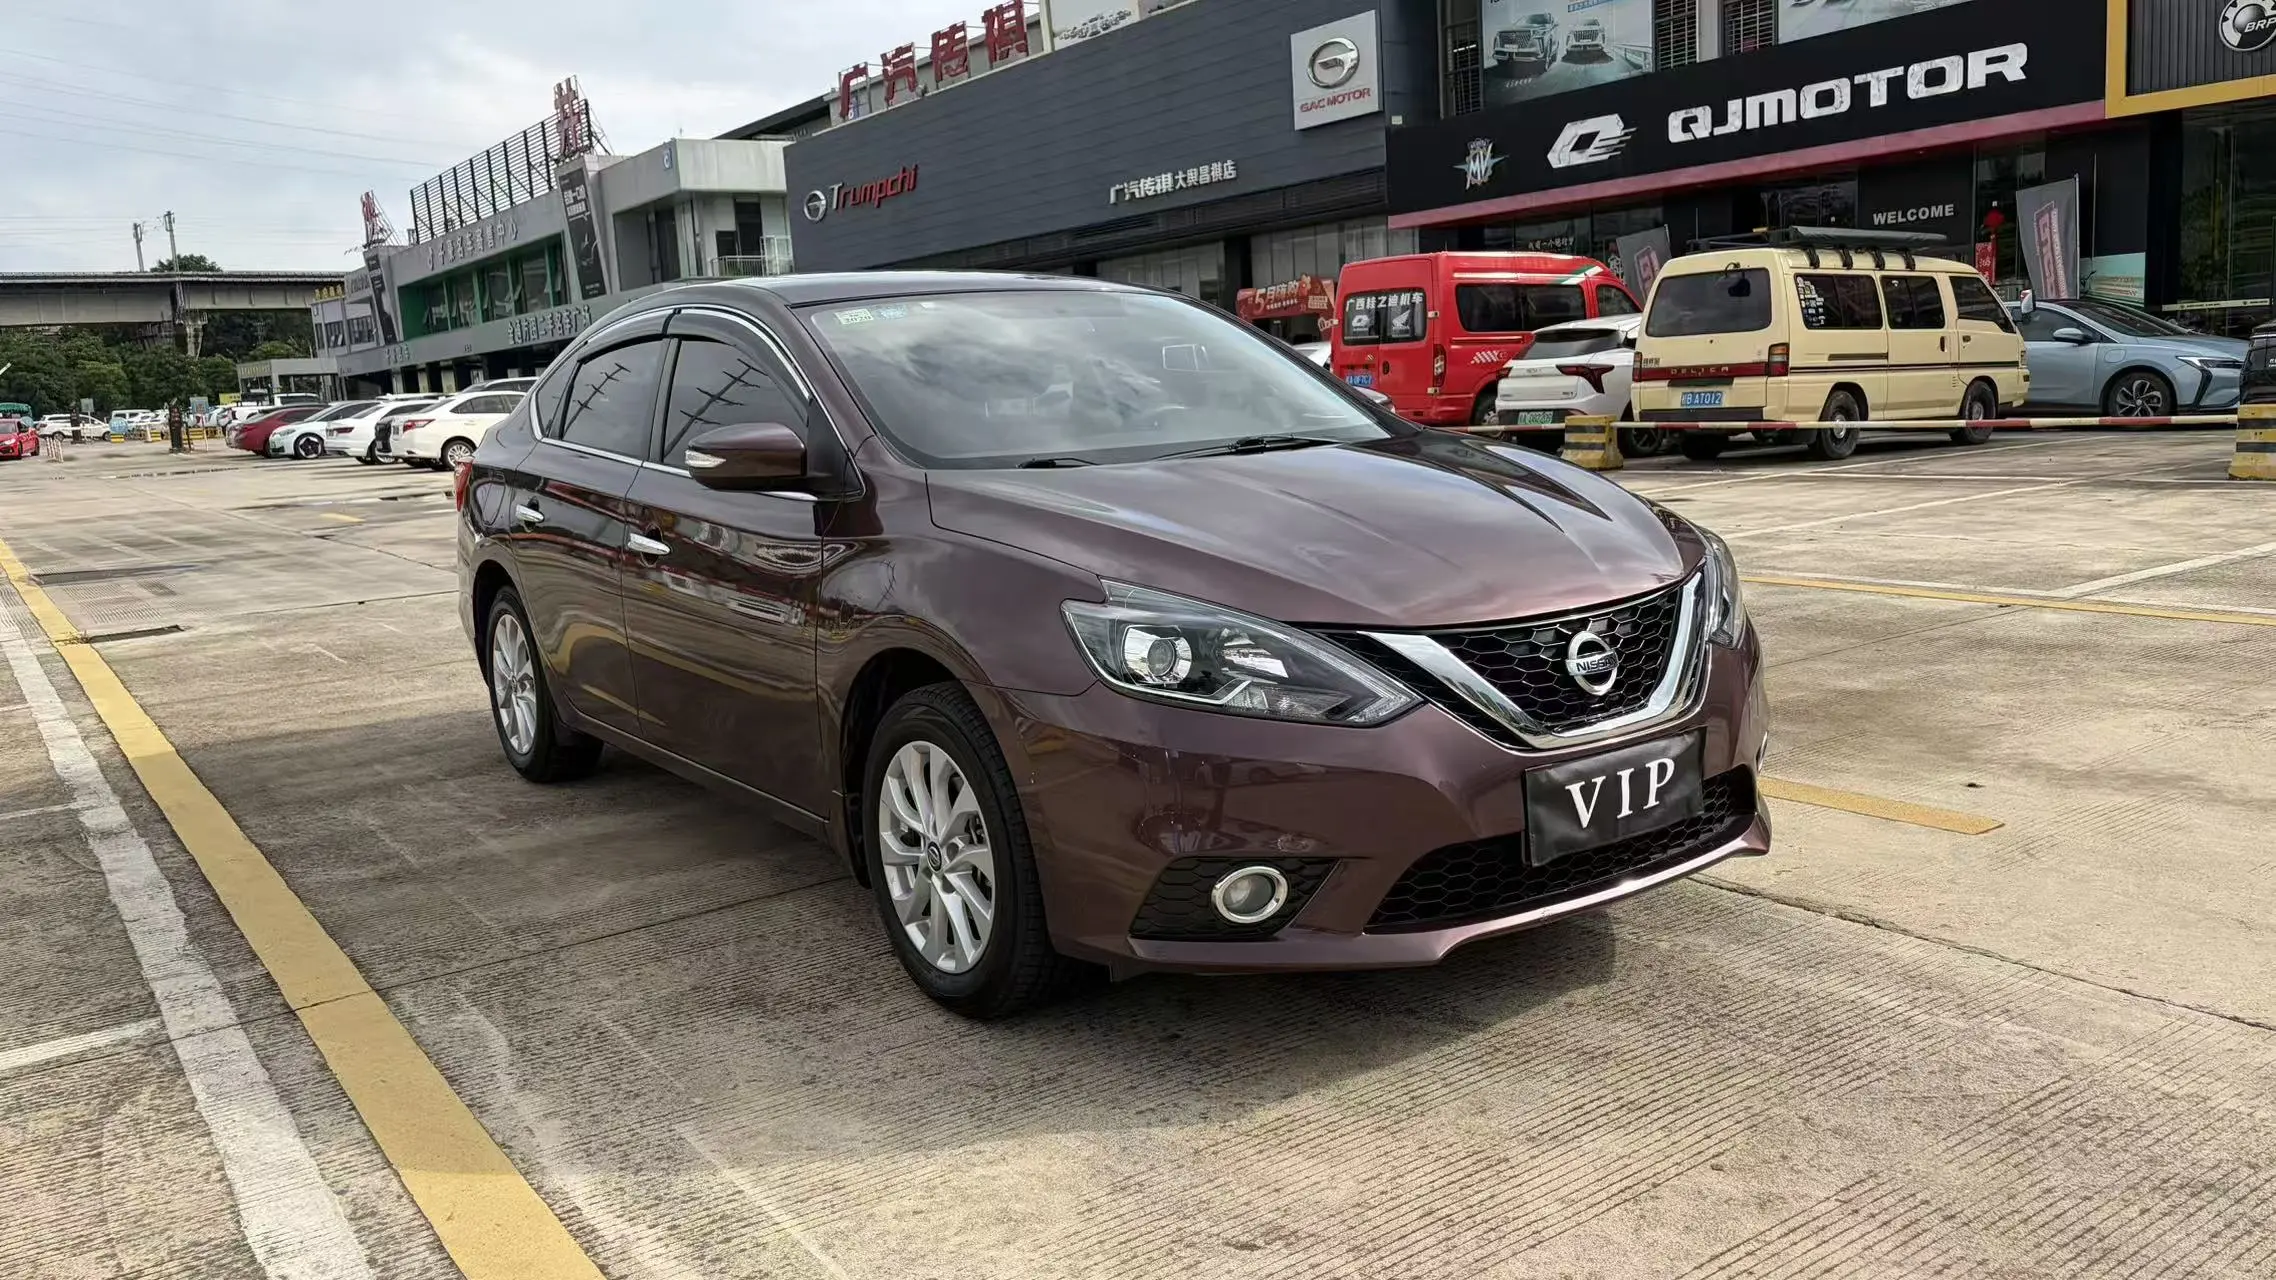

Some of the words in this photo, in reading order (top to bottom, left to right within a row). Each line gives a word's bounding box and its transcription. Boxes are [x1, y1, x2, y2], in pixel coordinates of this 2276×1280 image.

[2244, 17, 2276, 33] BRP
[839, 0, 1028, 120] 广汽传祺
[1300, 98, 1326, 112] GAC
[1327, 88, 1371, 106] MOTOR
[1668, 42, 2028, 143] QJMOTOR
[829, 163, 919, 214] Trumpchi
[1872, 204, 1954, 226] WELCOME
[1565, 757, 1676, 830] VIP
